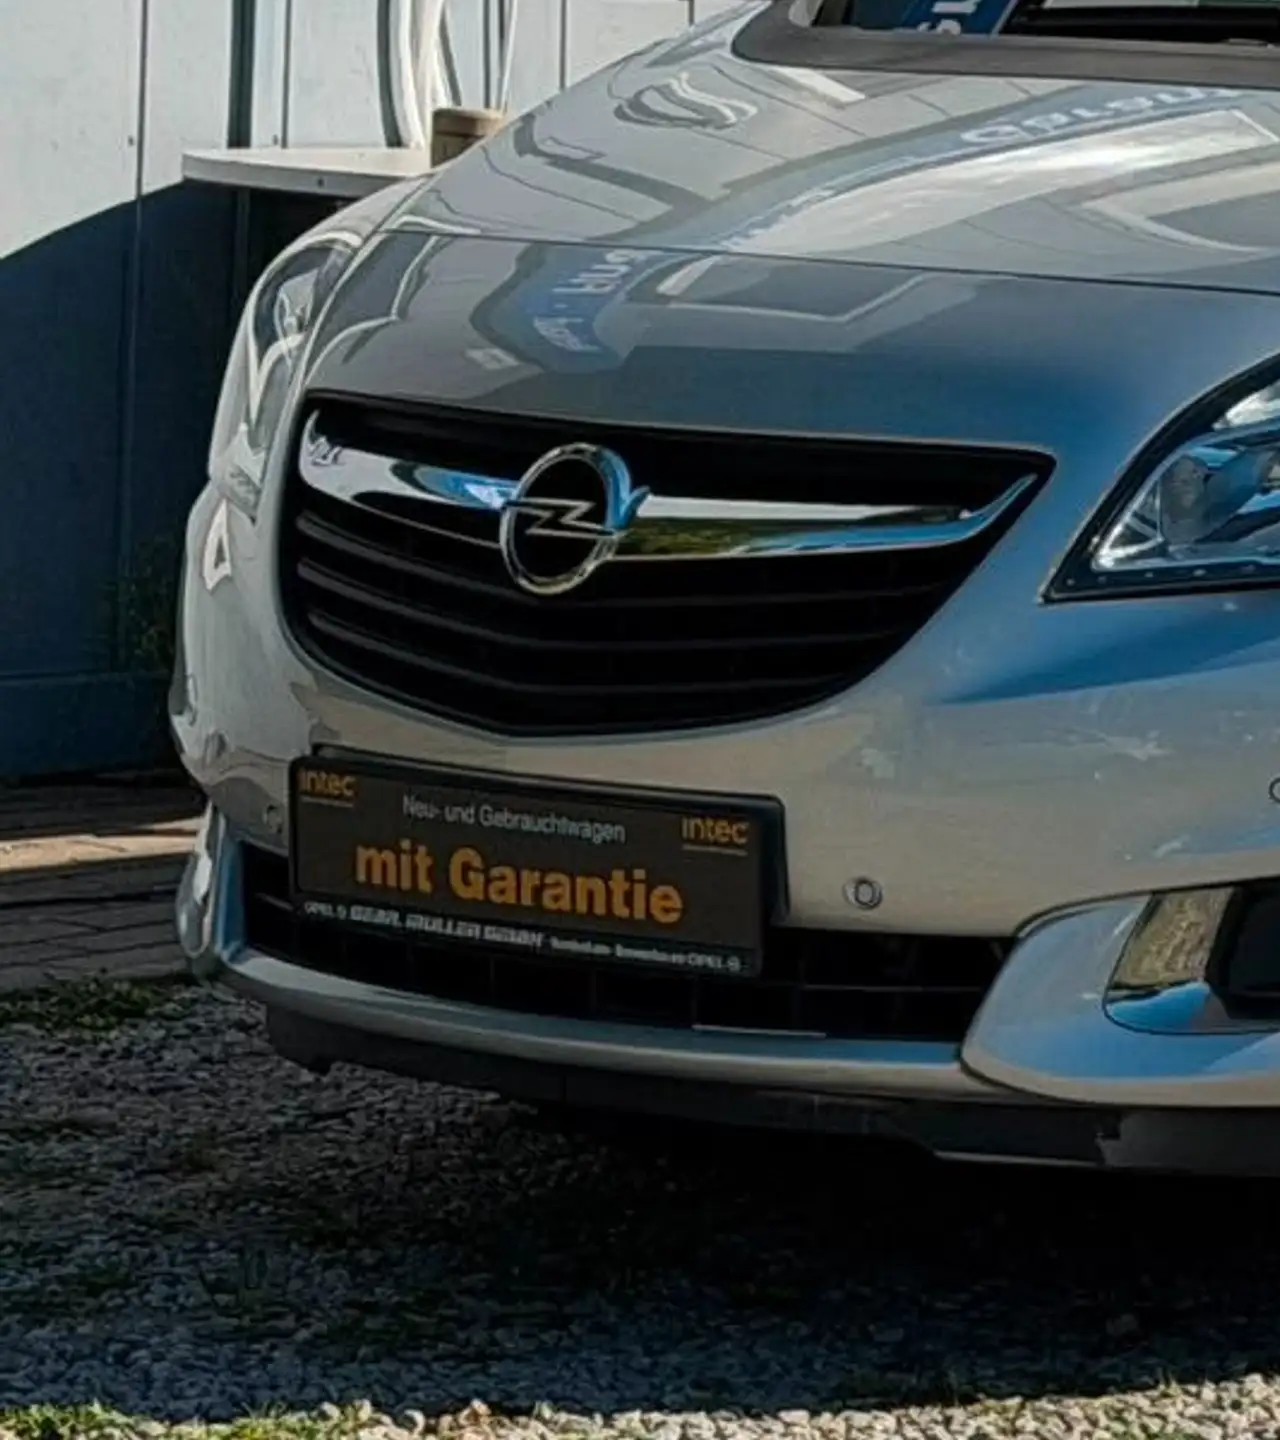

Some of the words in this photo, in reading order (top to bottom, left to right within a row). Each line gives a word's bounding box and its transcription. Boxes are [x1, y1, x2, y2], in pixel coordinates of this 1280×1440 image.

[444, 805, 476, 824] und
[479, 806, 626, 844] Gebrauchtwagen
[681, 815, 749, 845] intec
[355, 838, 433, 893] mit
[449, 847, 684, 923] Garantie
